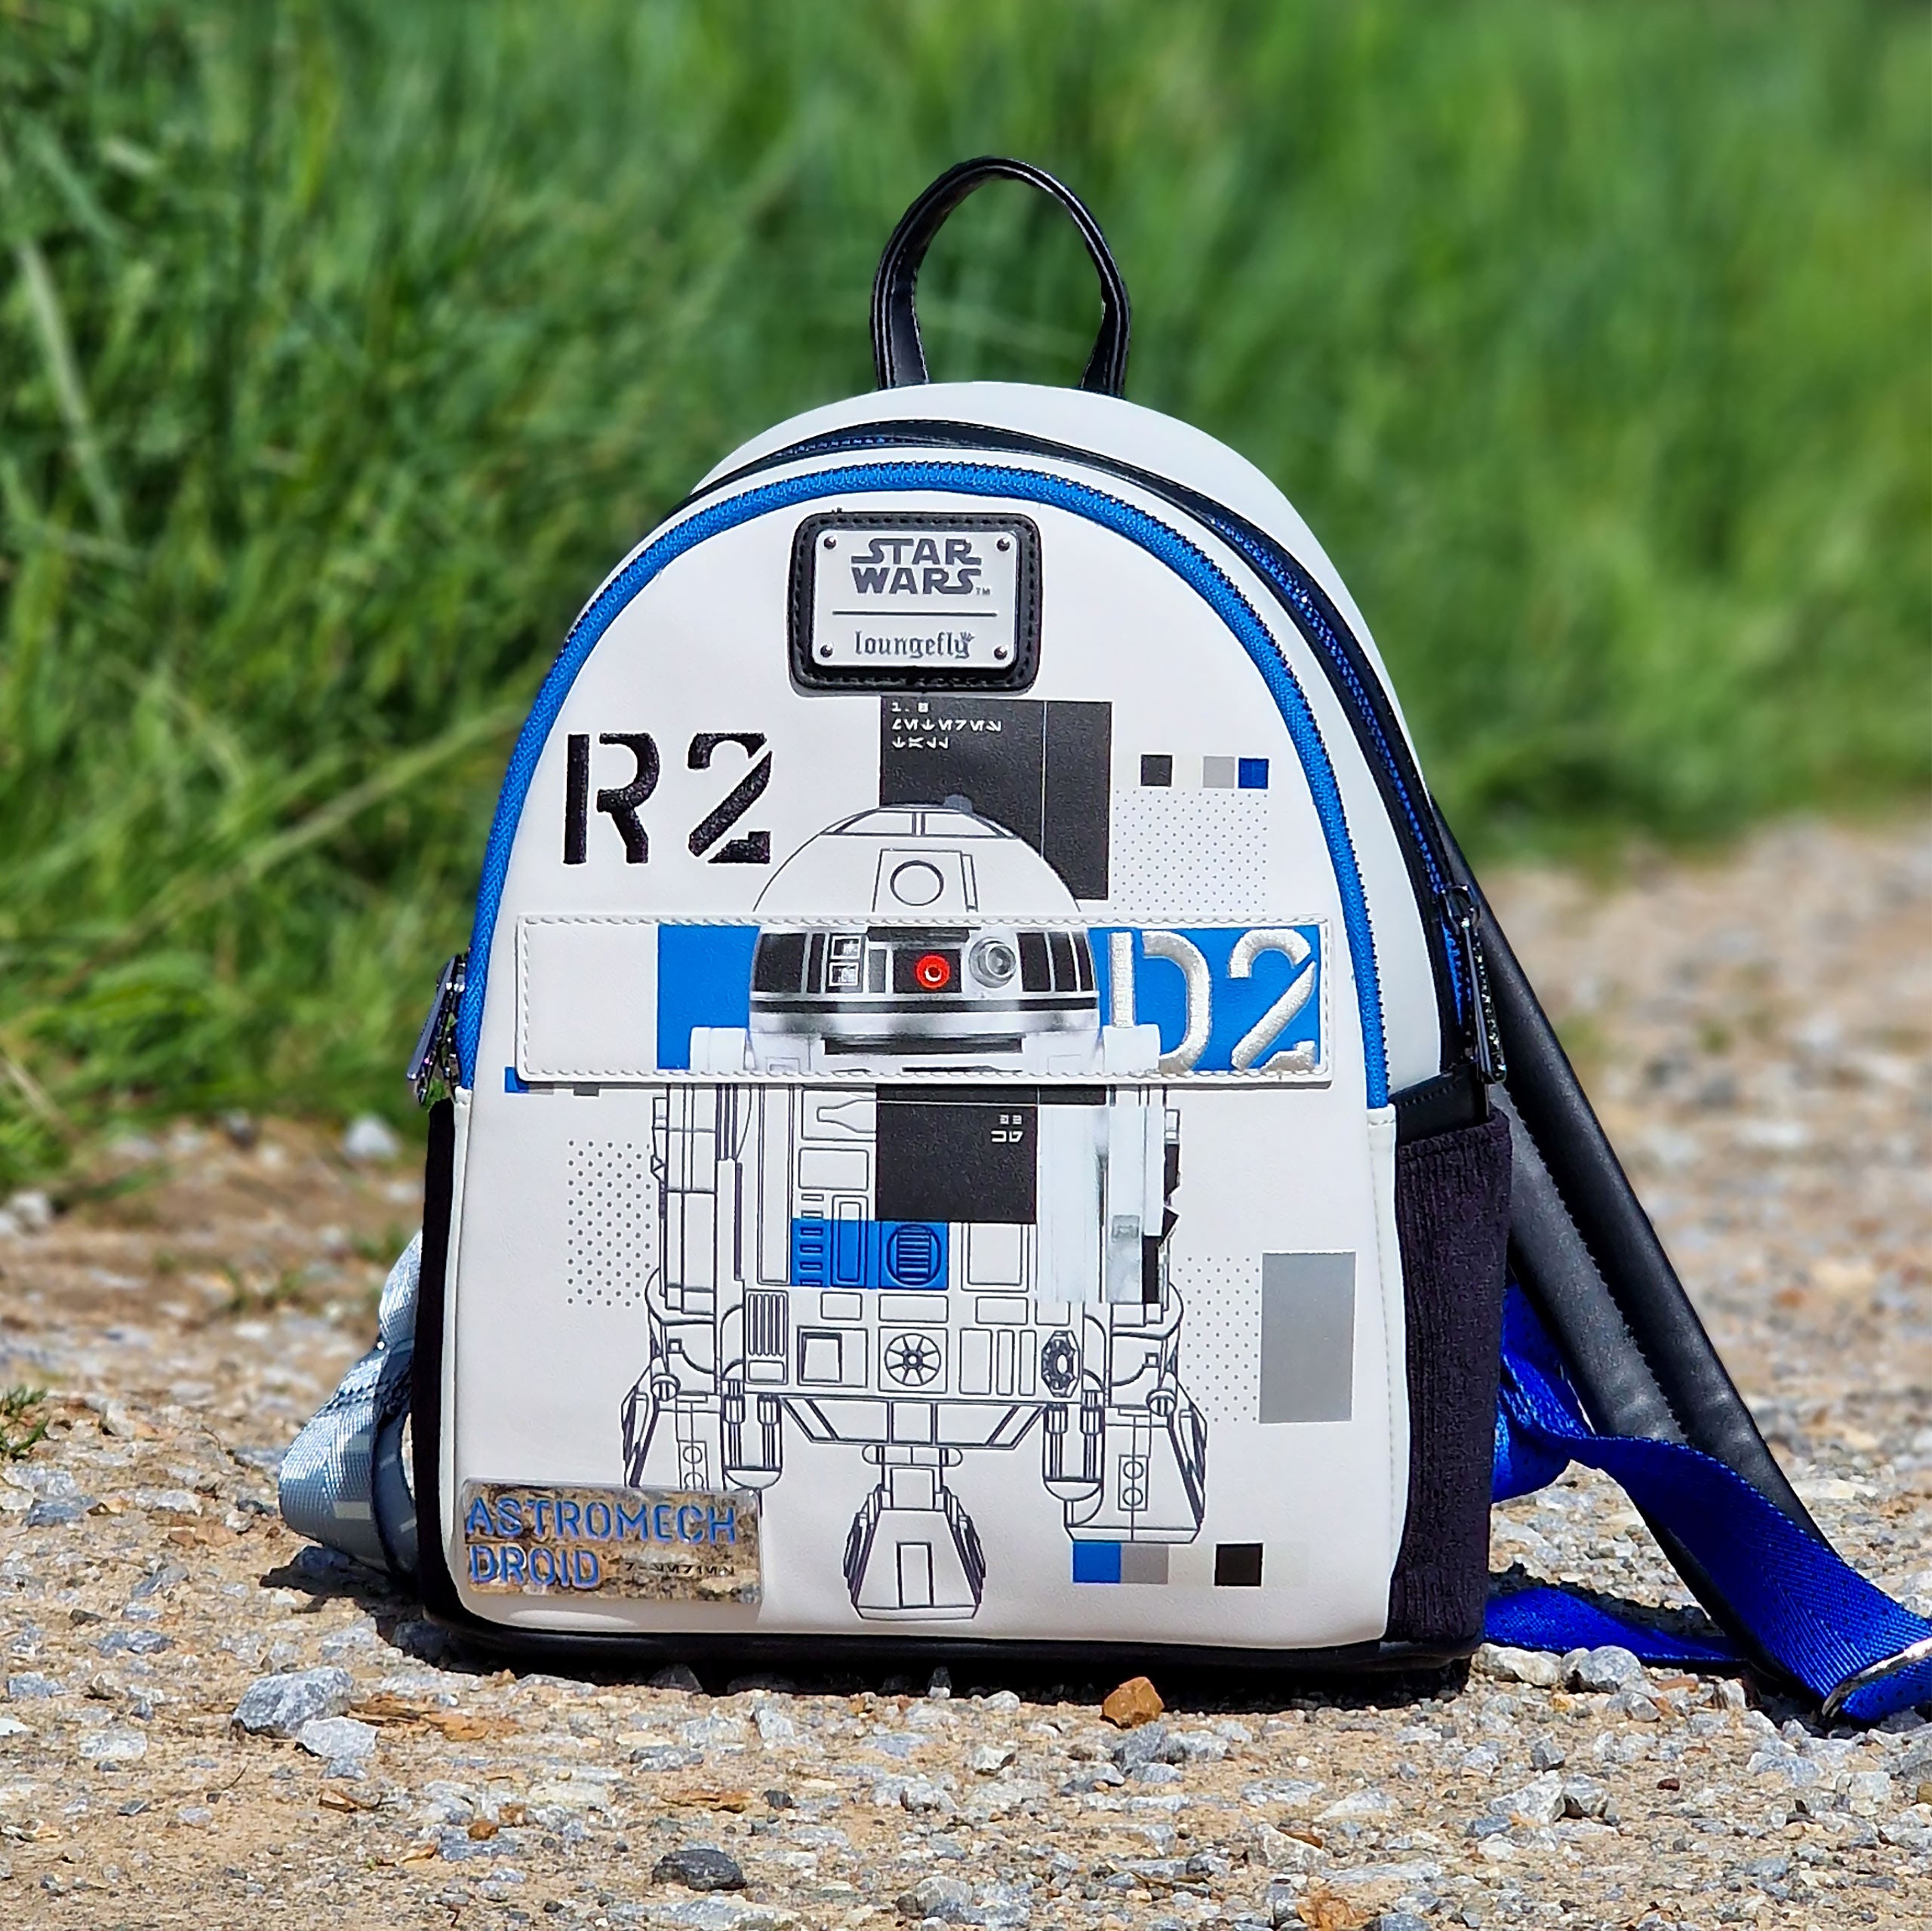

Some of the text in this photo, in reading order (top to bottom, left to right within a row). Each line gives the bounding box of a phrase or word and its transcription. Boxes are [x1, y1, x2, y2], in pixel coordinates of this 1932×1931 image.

[851, 538, 982, 565] STAR
[851, 567, 982, 595] WARS
[854, 630, 971, 659] loungefly
[563, 732, 772, 864] R2
[465, 1496, 737, 1545] ASTROMECH
[468, 1543, 601, 1588] DROID
